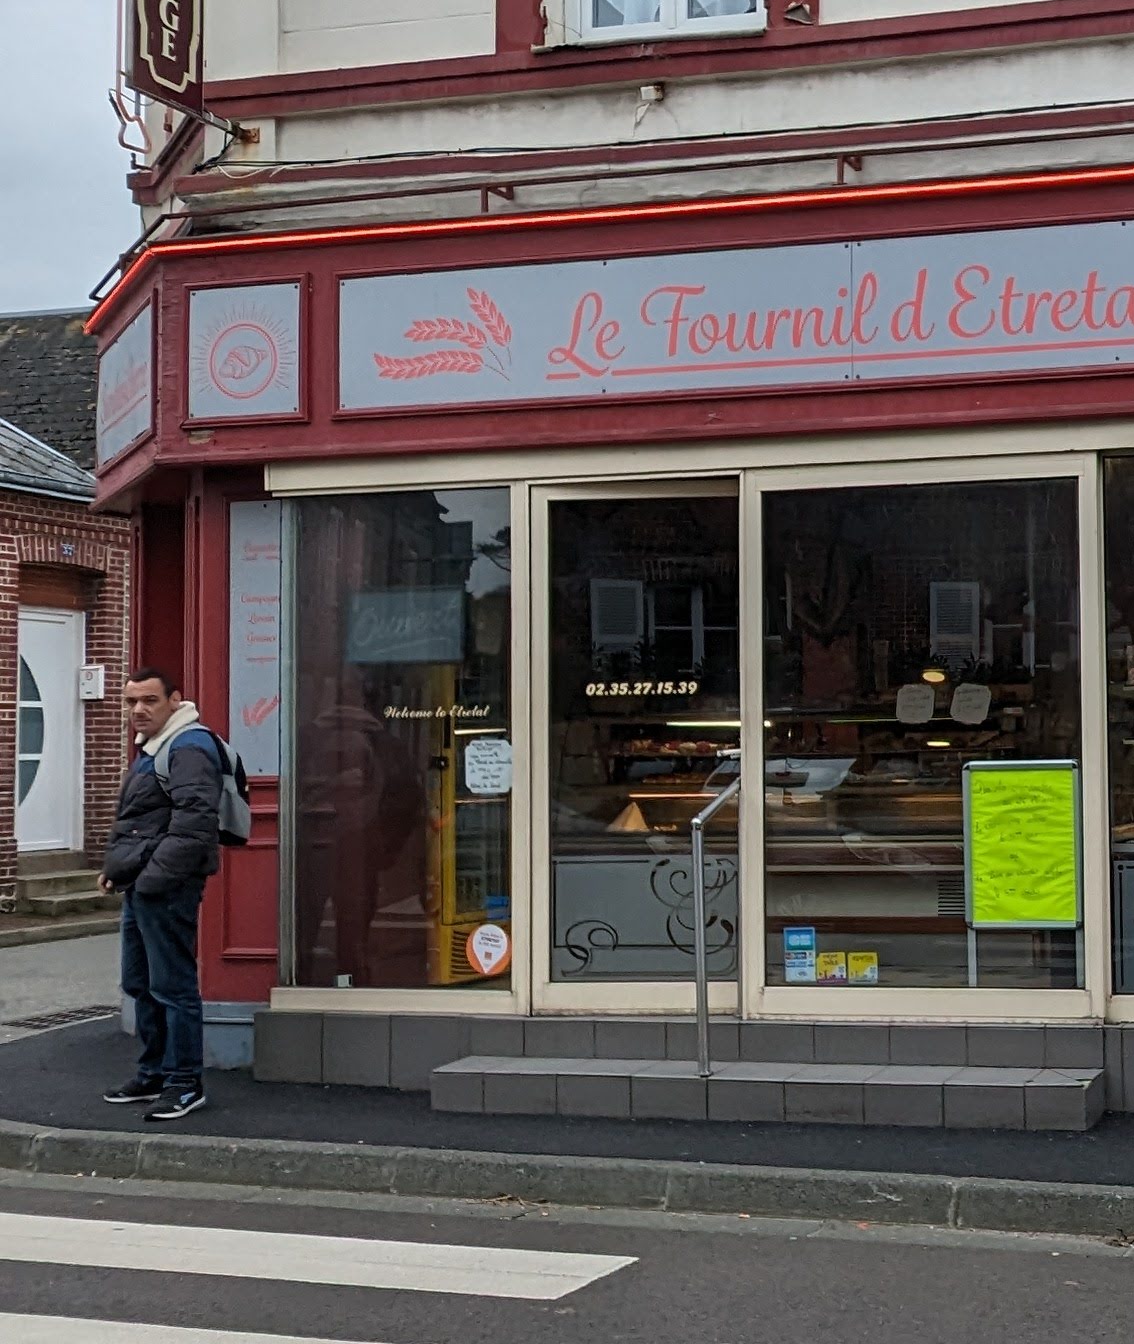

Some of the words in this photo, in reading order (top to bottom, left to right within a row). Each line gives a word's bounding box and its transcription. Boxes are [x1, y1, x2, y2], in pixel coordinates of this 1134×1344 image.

[548, 292, 625, 377] Le
[640, 271, 880, 357] Fournil
[585, 681, 698, 696] 02.35.27.15.39
[383, 706, 433, 719] Welcome
[435, 706, 446, 718] to
[449, 704, 491, 718] Etretat
